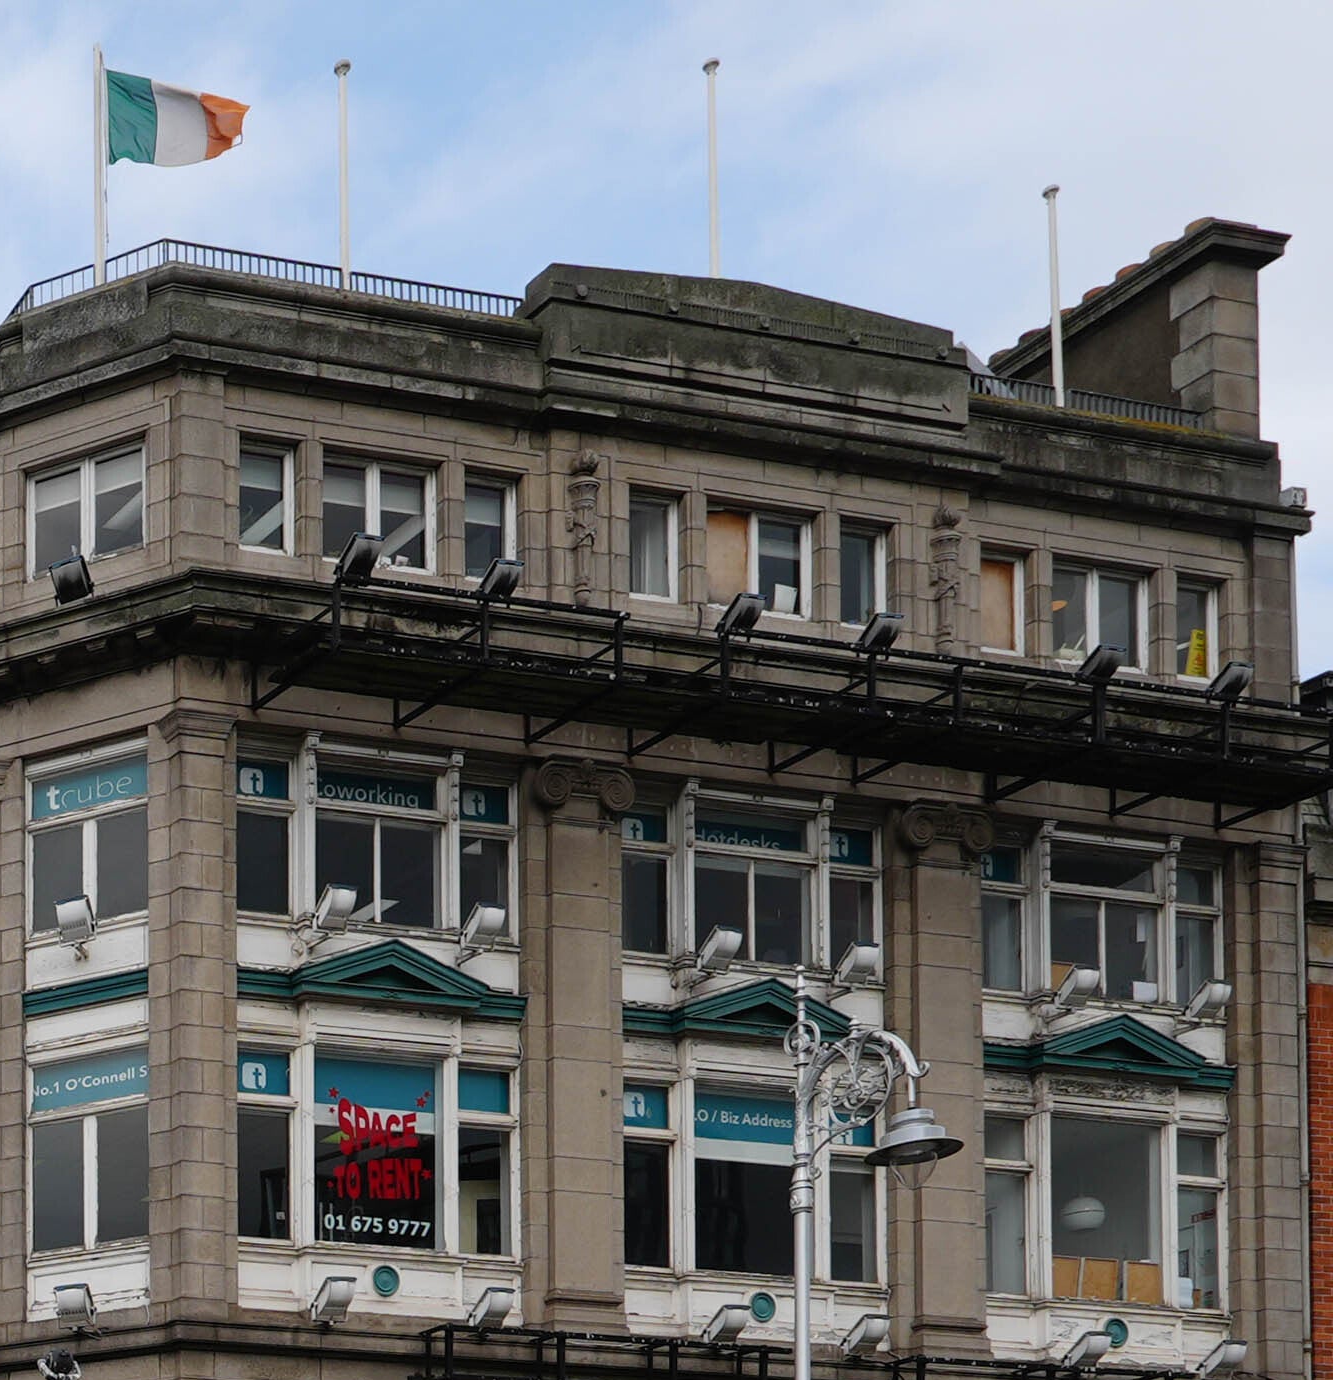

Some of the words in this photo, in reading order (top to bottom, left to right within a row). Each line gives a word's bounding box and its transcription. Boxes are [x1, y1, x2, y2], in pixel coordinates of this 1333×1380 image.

[46, 776, 133, 810] tcube
[338, 1098, 419, 1155] SPACE
[720, 1111, 739, 1125] Biz
[741, 1113, 793, 1129] Address
[334, 1161, 361, 1199] TO
[367, 1159, 422, 1200] RENT
[324, 1213, 345, 1230] 01
[351, 1215, 383, 1233] 675
[388, 1218, 431, 1237] 9777
